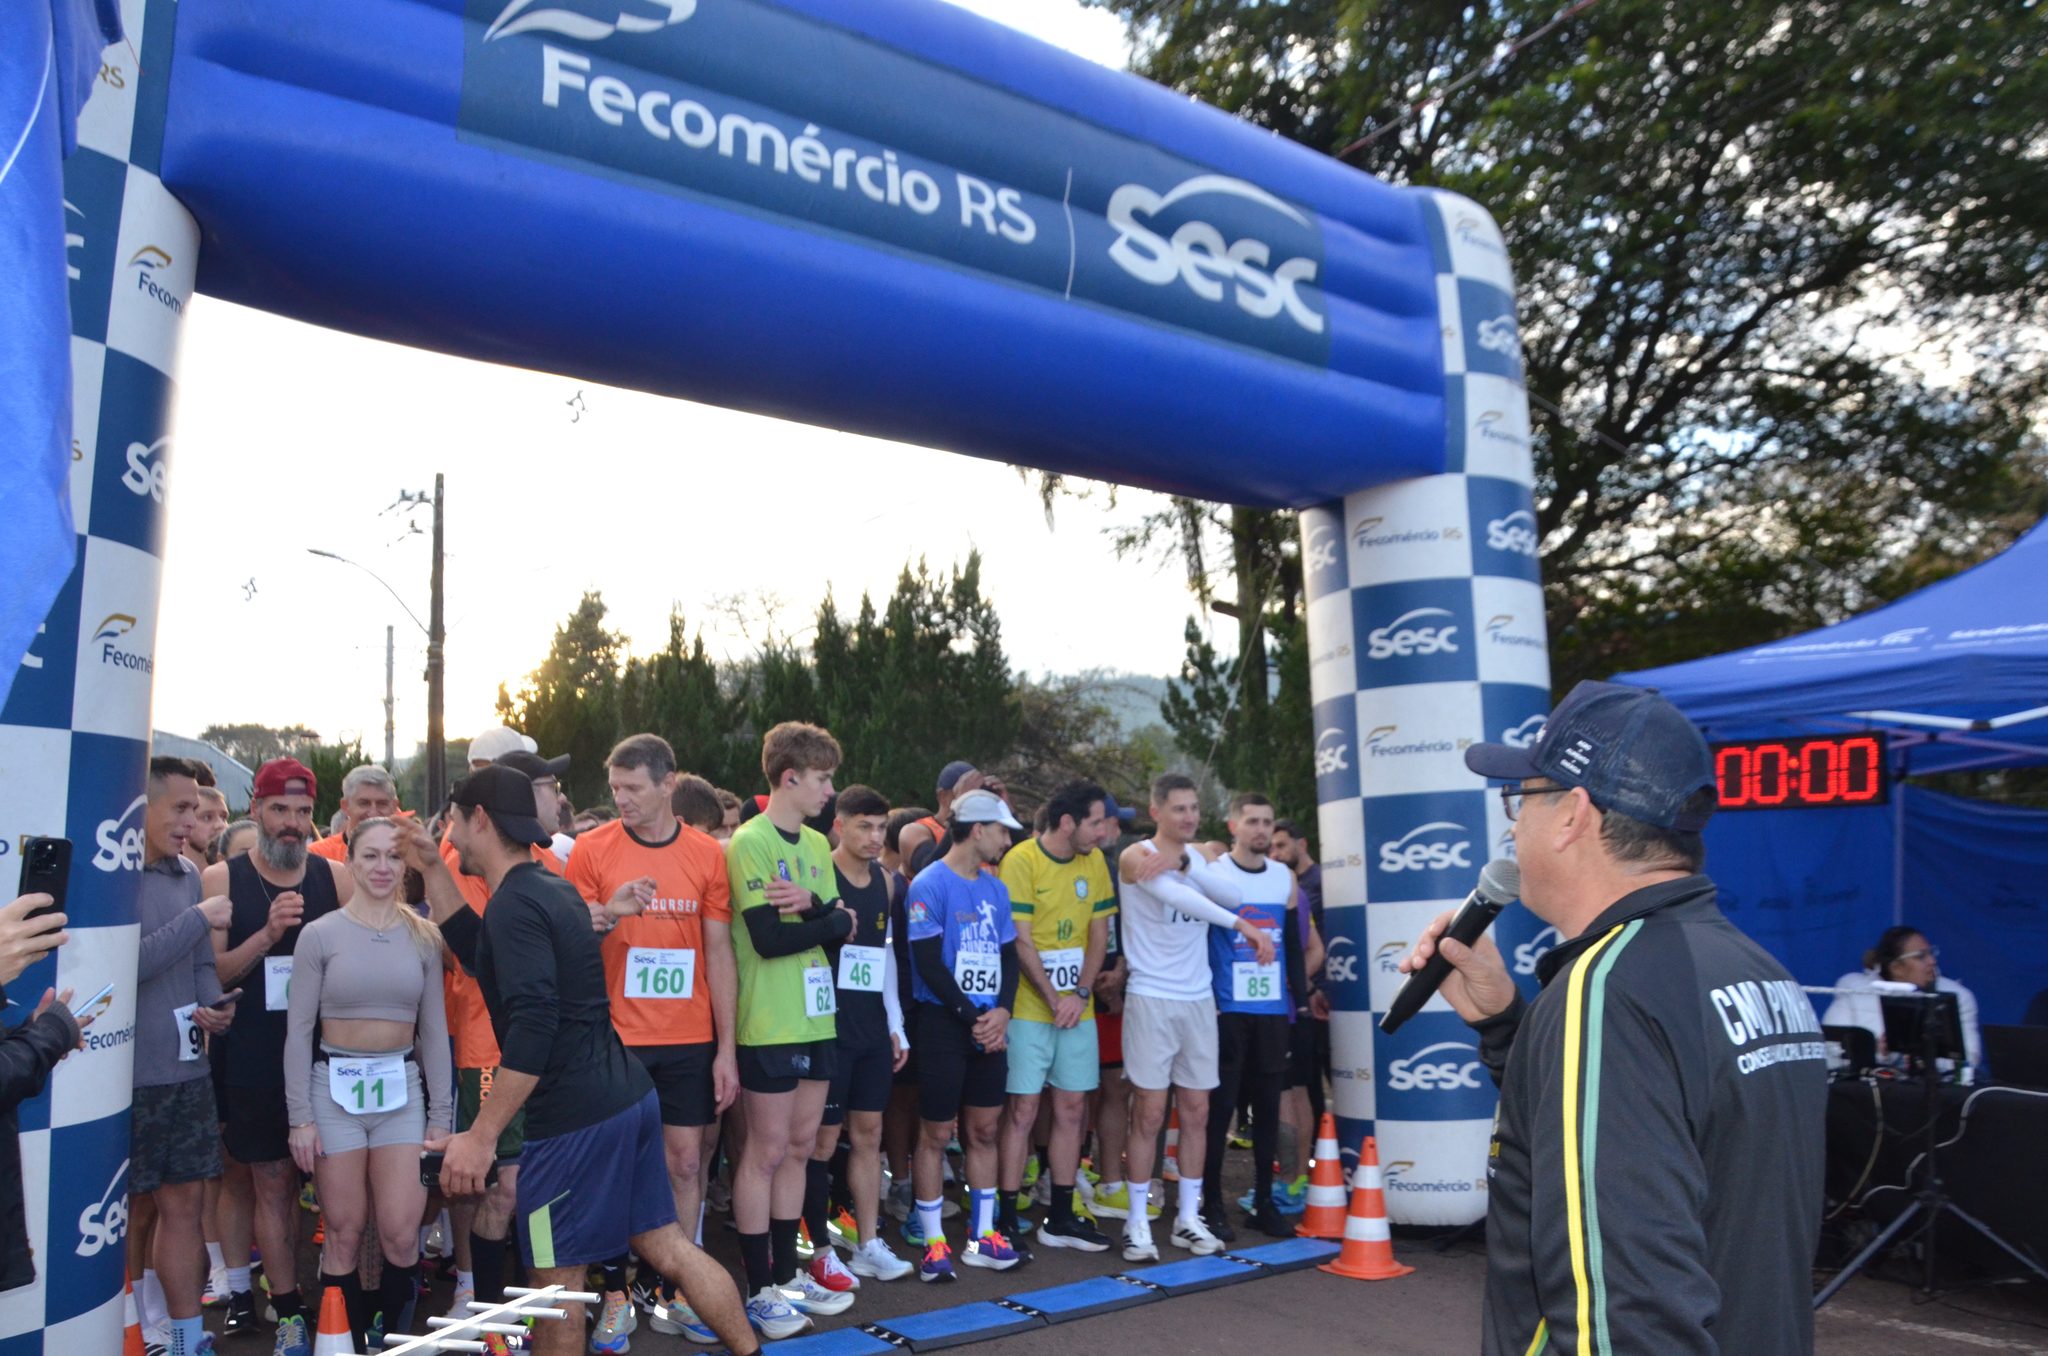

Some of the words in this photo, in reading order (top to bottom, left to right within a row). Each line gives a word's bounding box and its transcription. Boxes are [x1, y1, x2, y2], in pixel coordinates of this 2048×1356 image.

[542, 44, 941, 215] Fecomércio
[957, 173, 1036, 244] RS
[1716, 737, 1879, 807] 00:00
[636, 966, 685, 994] 160
[849, 962, 872, 987] 46
[961, 969, 998, 993] 854
[1247, 976, 1271, 998] 85
[816, 985, 831, 1012] 62
[351, 1078, 384, 1109] 11
[1388, 1178, 1472, 1193] Fecomércio
